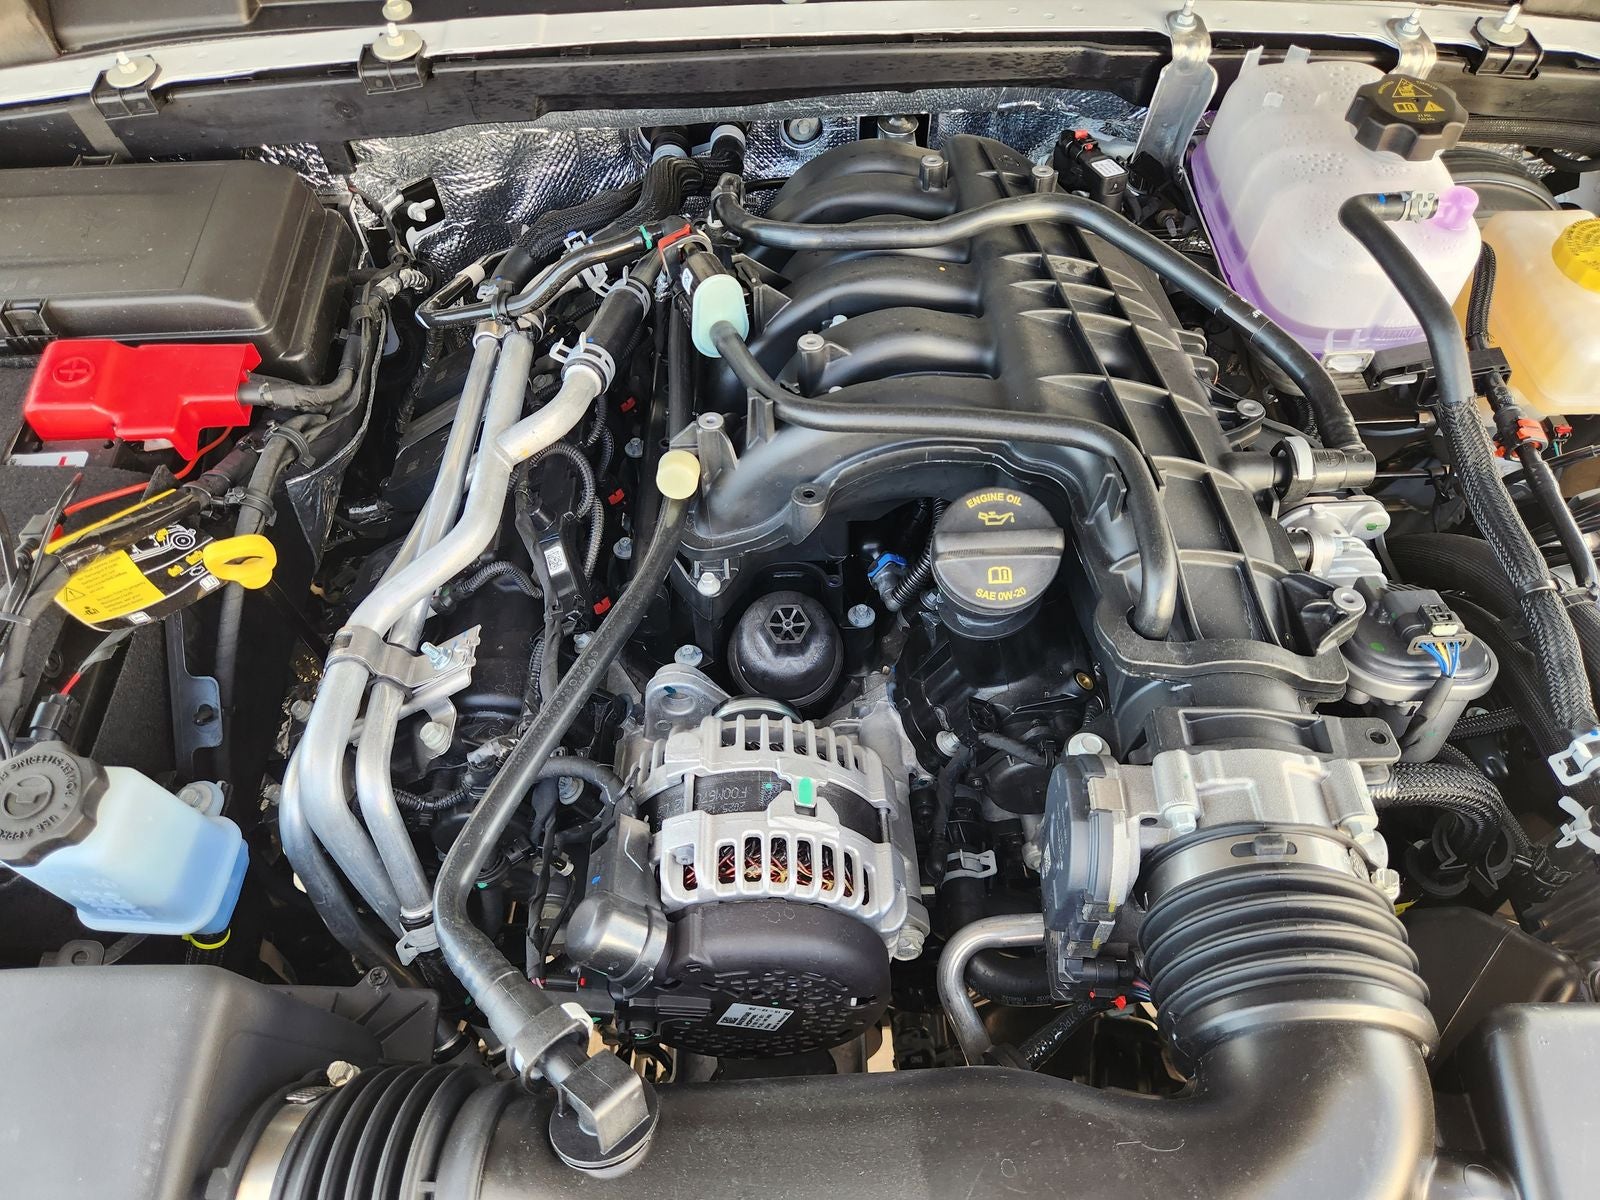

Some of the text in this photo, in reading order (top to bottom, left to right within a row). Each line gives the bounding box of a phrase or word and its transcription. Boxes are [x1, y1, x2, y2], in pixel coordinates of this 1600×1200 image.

[965, 492, 1023, 509] ENGINE OIL
[975, 587, 1026, 600] SAE 0W-20
